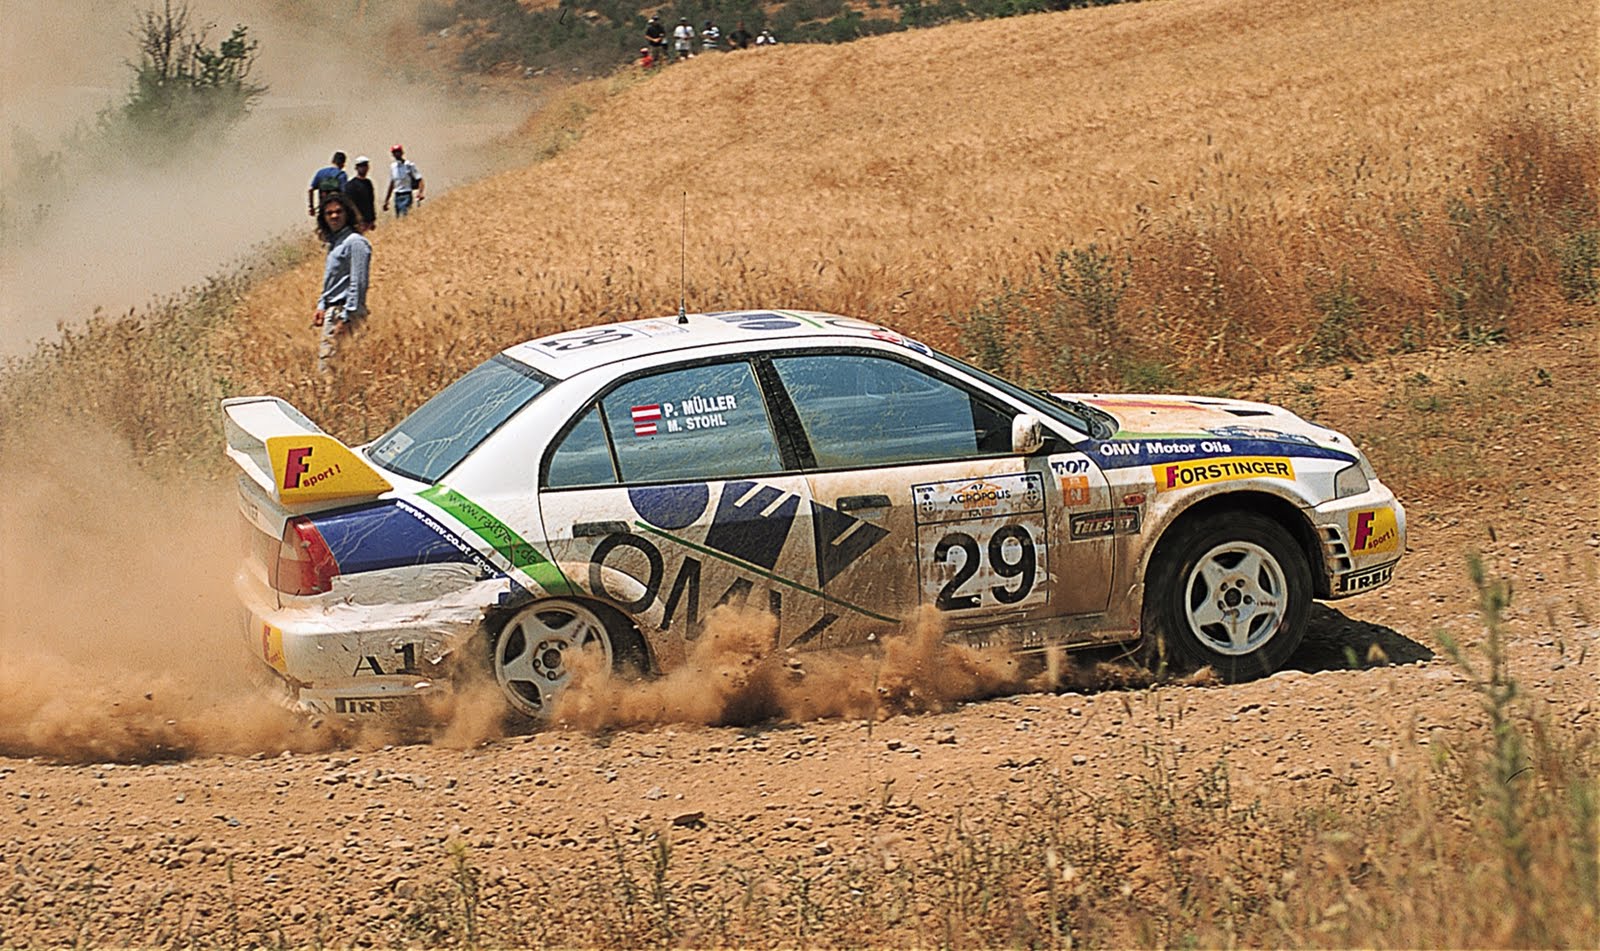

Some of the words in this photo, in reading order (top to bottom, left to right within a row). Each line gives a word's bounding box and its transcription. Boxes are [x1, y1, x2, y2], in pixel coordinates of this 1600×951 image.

[663, 402, 679, 418] P.
[681, 395, 737, 416] MÜLLER
[667, 419, 683, 433] M.
[686, 414, 727, 430] STOHL
[1100, 442, 1140, 456] OMV
[1147, 442, 1196, 455] Motor
[1200, 440, 1232, 453] Oils
[283, 447, 313, 490] F
[1051, 460, 1090, 475] TOP
[1166, 462, 1290, 489] FORSTINGER
[949, 490, 1011, 504] ACROPOLIS
[1352, 511, 1375, 550] F
[934, 524, 1036, 611] 29
